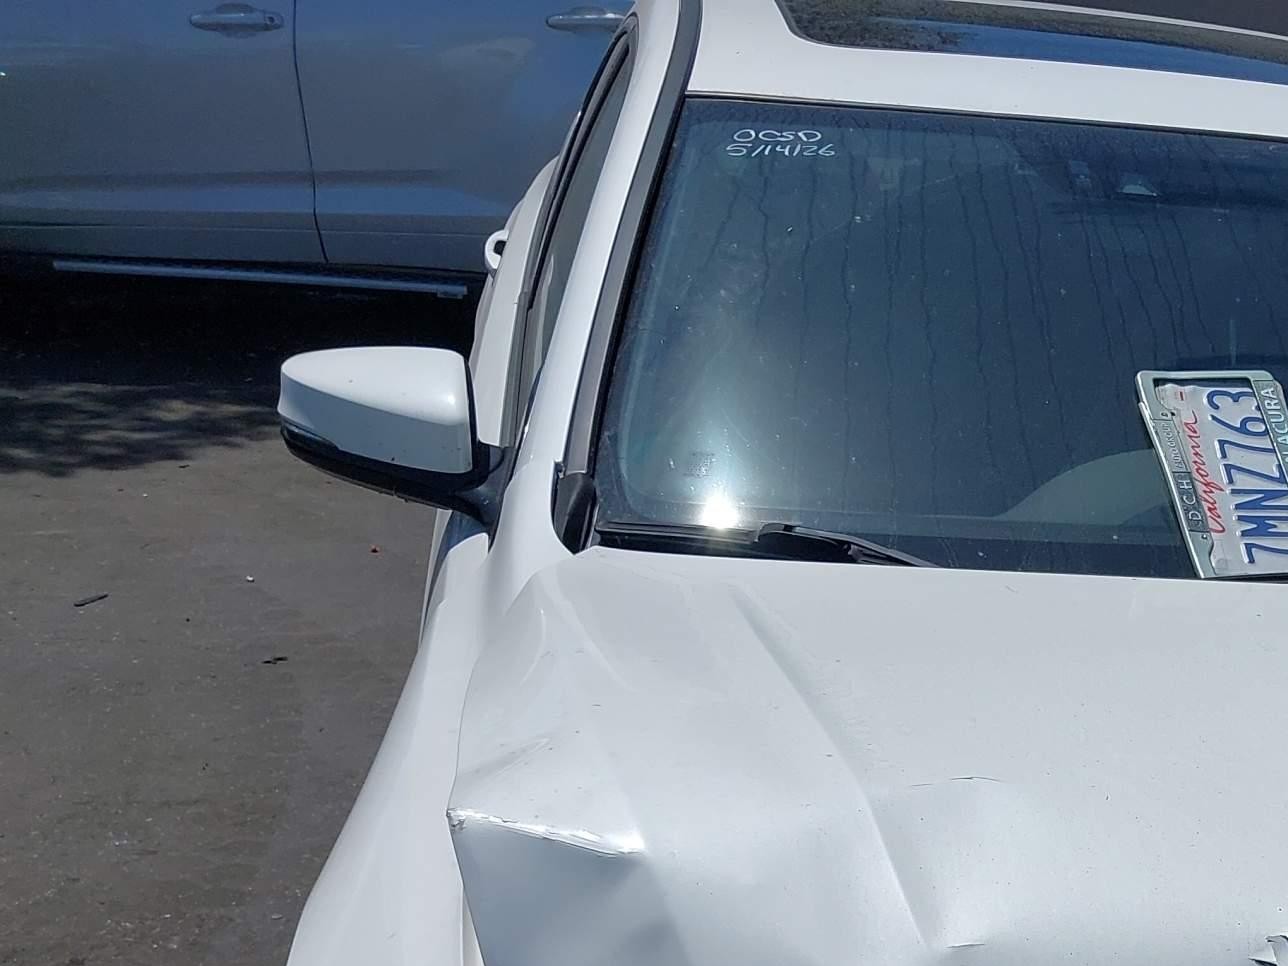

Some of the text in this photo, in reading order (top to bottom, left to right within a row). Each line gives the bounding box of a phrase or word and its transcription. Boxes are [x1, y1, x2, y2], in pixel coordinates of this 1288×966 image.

[733, 128, 823, 143] OCSD
[725, 143, 836, 157] 5/14/26
[1183, 410, 1226, 534] California
